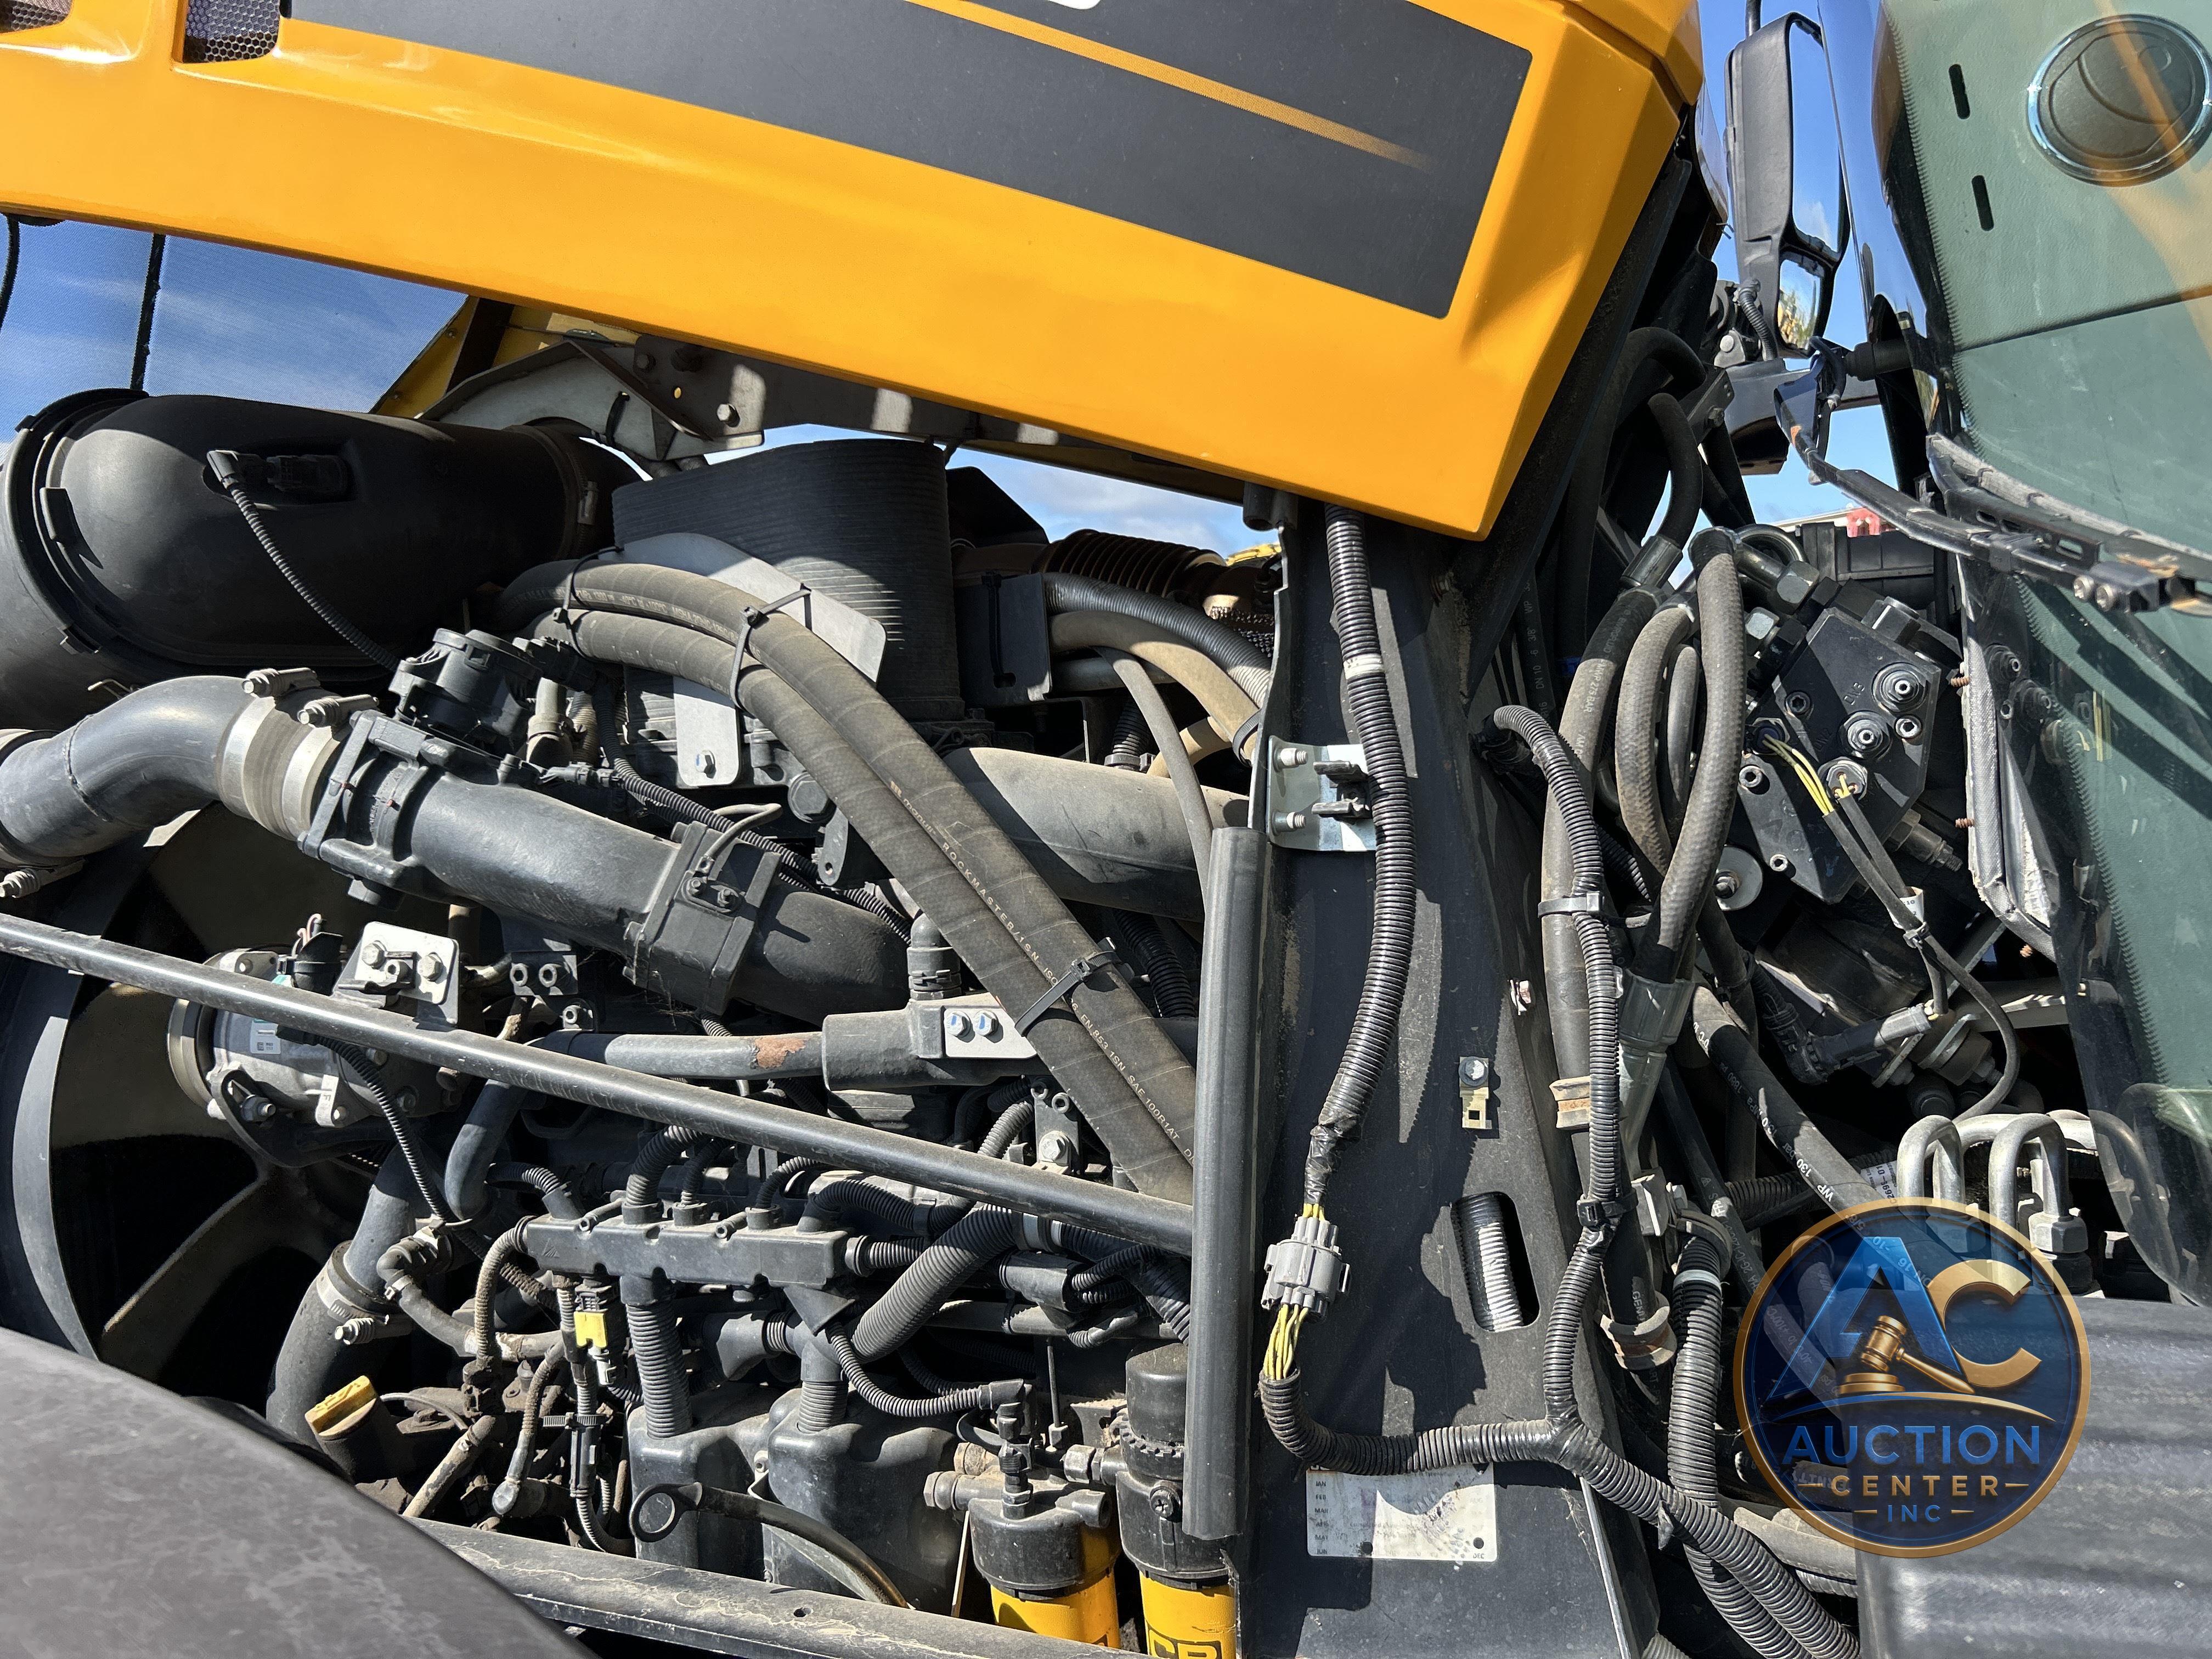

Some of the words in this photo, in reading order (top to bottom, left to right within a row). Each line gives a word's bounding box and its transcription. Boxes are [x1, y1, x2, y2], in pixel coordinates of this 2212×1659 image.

[1523, 600, 1533, 613] WP
[1532, 664, 1542, 675] 10
[1080, 1013, 1094, 1030] EN
[1091, 1028, 1110, 1051] 853
[1107, 1049, 1126, 1072] 1SN
[1126, 1074, 1146, 1097] SAE
[1142, 1096, 1180, 1142] 100R1AT
[1780, 1141, 1798, 1159] bar
[1793, 1156, 1814, 1178] 130
[1815, 1180, 1836, 1203] WP
[1871, 1233, 1892, 1254] -10
[1896, 1256, 1914, 1273] 16
